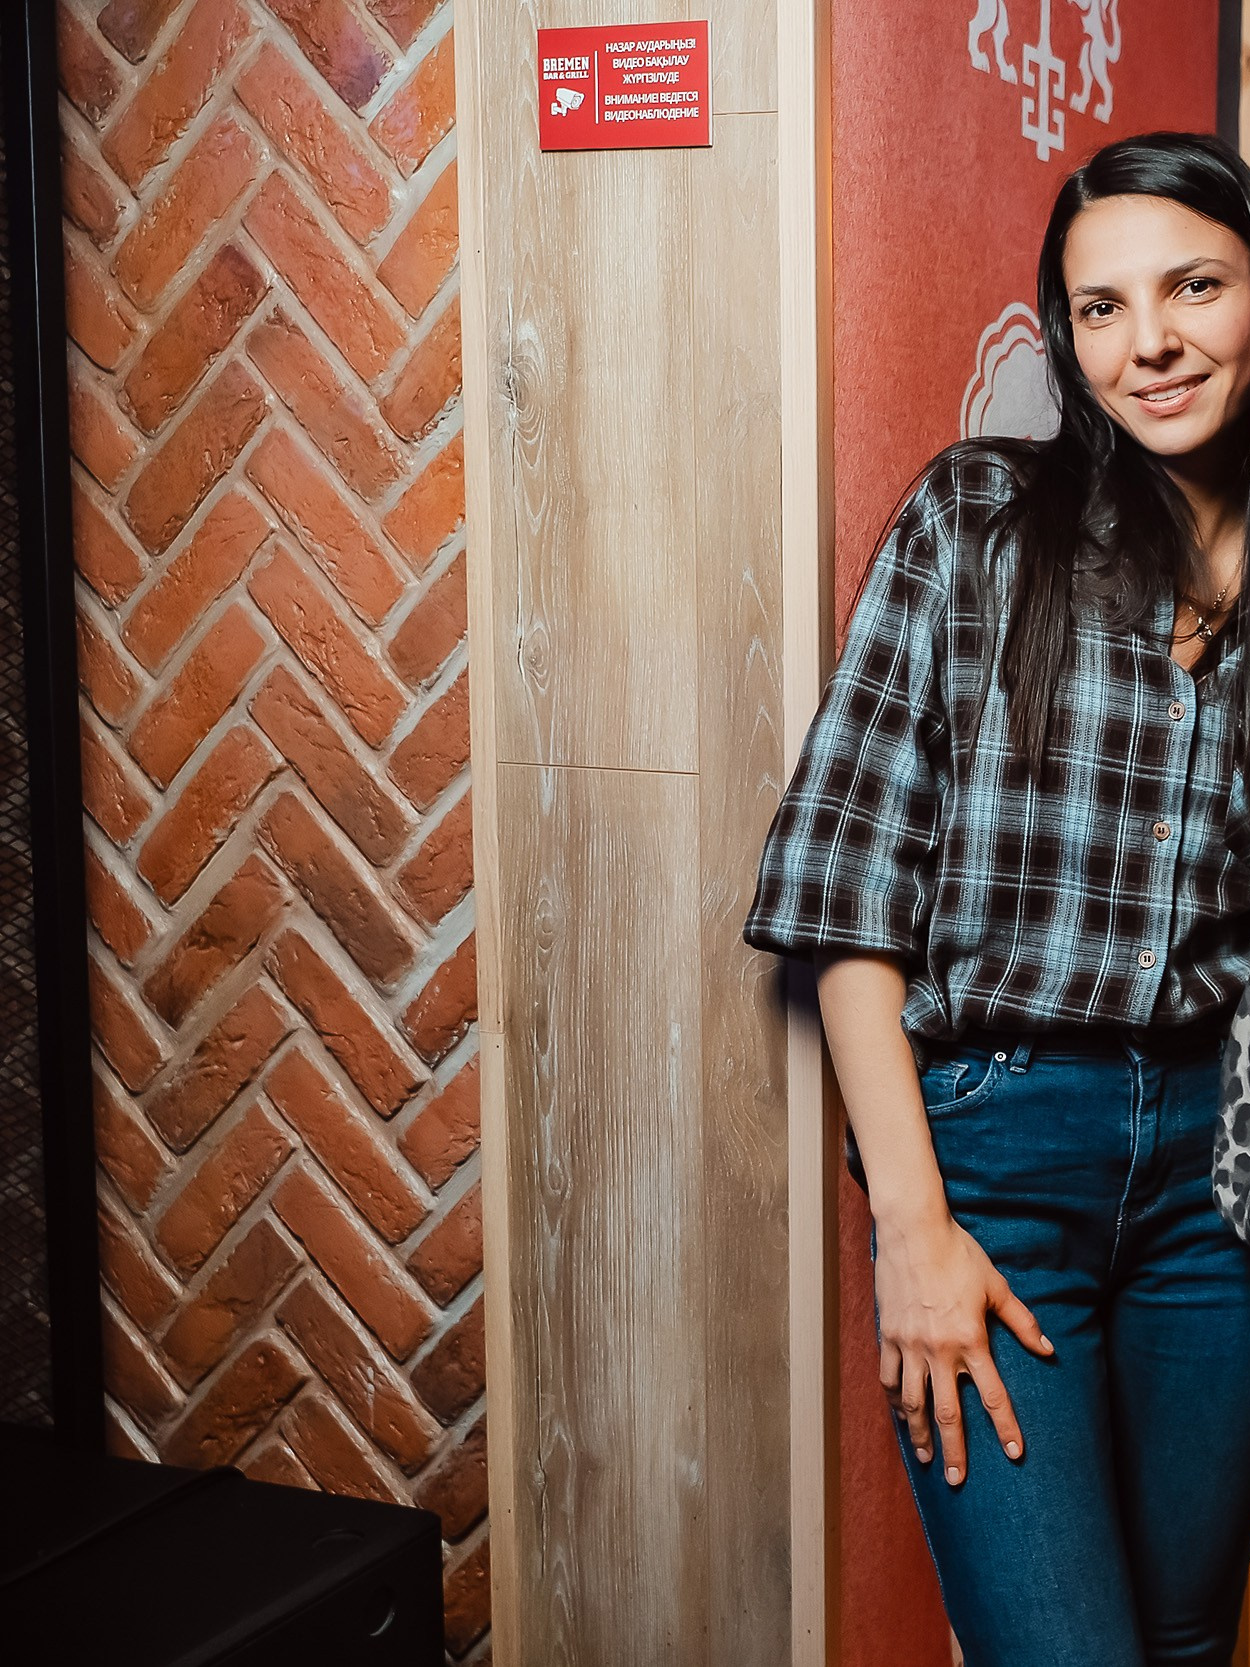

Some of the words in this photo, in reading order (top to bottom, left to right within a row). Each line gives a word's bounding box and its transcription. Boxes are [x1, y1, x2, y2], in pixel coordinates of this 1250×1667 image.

[605, 42, 635, 53] НАЗАР
[543, 56, 589, 72] BREMEN
[612, 57, 644, 70] ВИДЕО
[645, 55, 690, 68] БАҚЫЛАУ
[543, 72, 558, 80] BAR
[559, 71, 565, 80] &
[565, 71, 589, 79] GRILL
[660, 91, 699, 104] ВЕДЕТСЯ
[604, 107, 699, 122] ВИДЕОНАБЛЮДЕНИЕ
